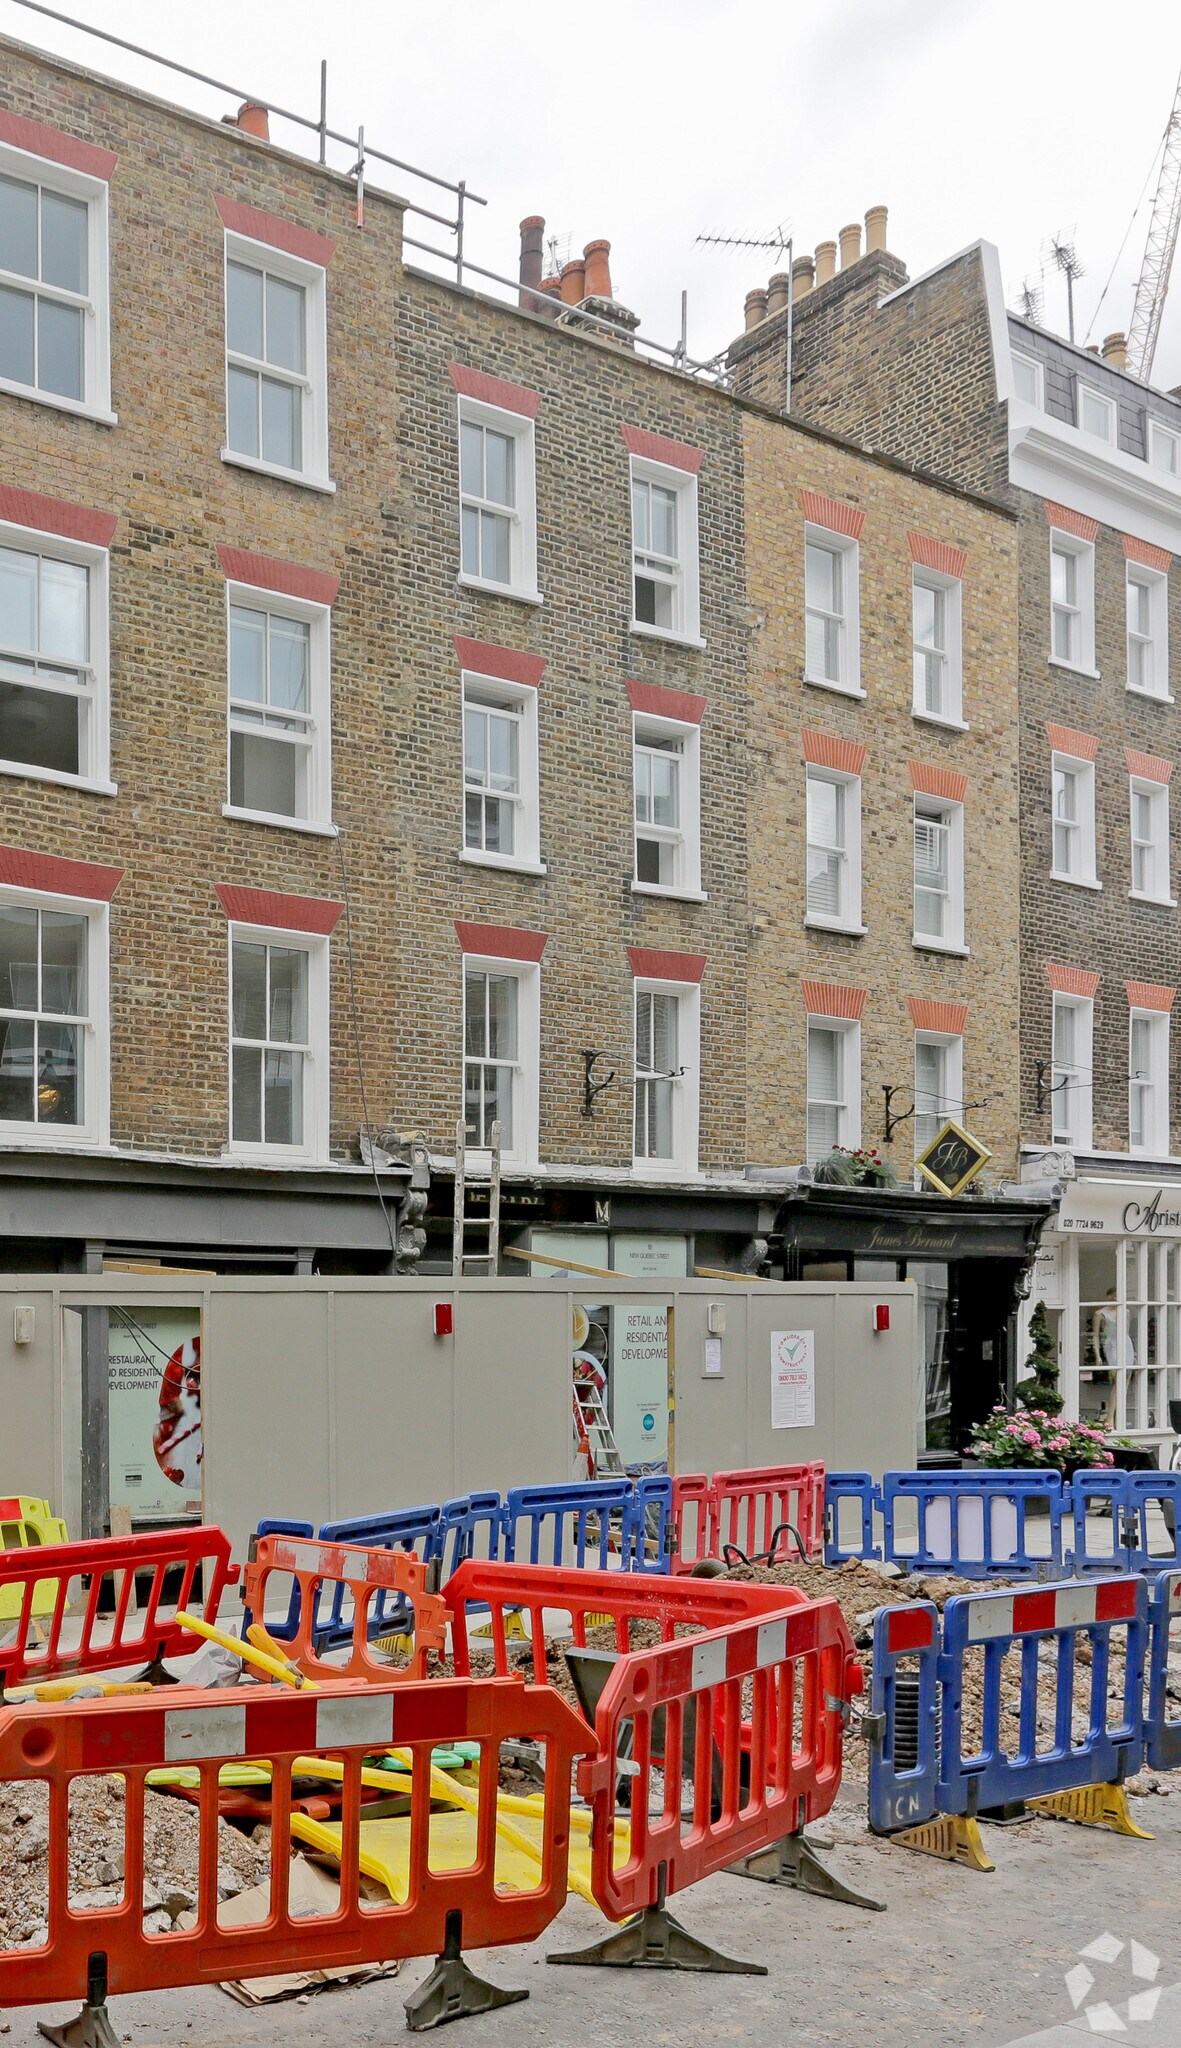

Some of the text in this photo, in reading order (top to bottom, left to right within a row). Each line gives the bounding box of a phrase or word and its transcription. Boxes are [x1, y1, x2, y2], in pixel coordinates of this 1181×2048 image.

[1063, 1219, 1073, 1228] 020
[1075, 1219, 1089, 1229] 7724
[863, 1224, 901, 1249] James
[904, 1225, 958, 1248] Bernard
[627, 1315, 667, 1326] RETAIL AN
[626, 1332, 668, 1343] RESIDENTIA
[108, 1355, 156, 1364] RESTAURANT
[621, 1348, 668, 1360] DEVELOPME
